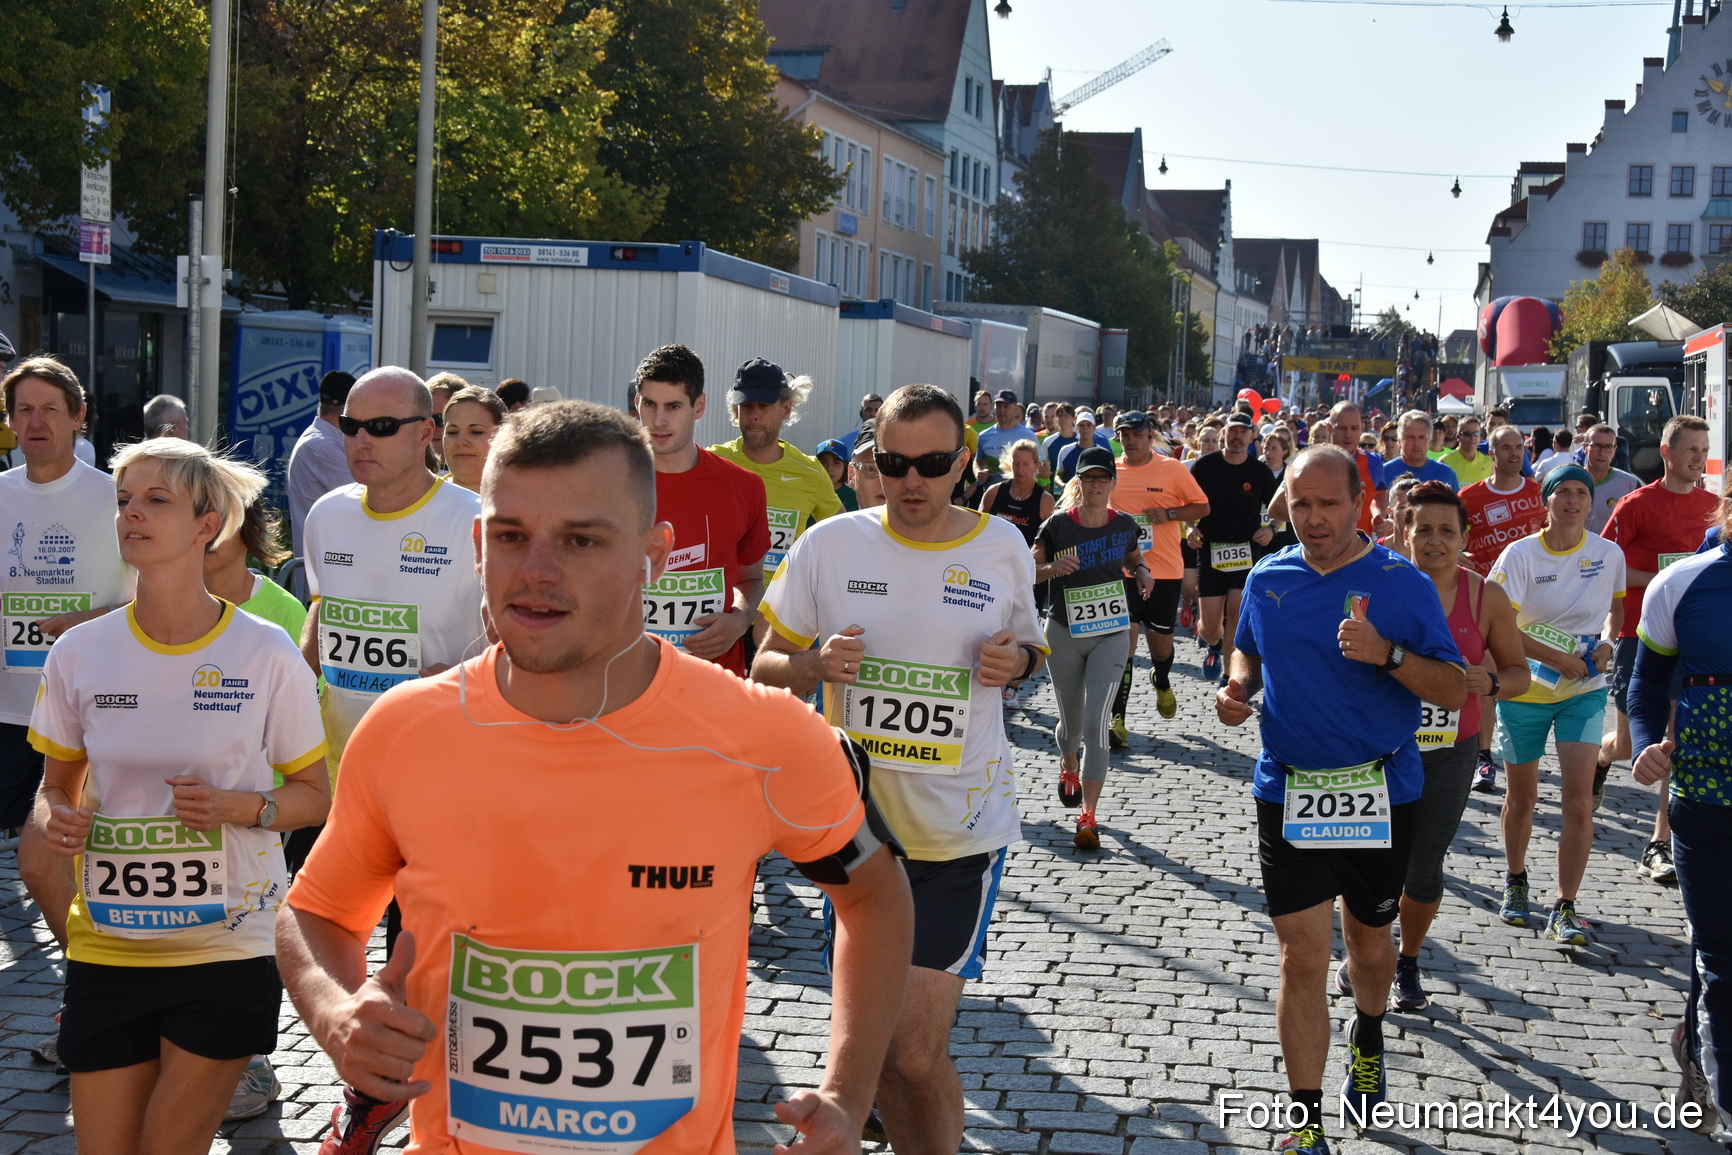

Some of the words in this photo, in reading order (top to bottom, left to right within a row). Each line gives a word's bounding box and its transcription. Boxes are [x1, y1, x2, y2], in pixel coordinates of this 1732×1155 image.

[497, 247, 509, 255] TOI
[69, 343, 86, 355] STRE
[1319, 361, 1357, 371] START
[1510, 496, 1544, 513] rau
[767, 511, 791, 526] CK
[403, 538, 424, 552] 20
[1078, 537, 1108, 556] START
[1112, 531, 1135, 546] EASY
[324, 552, 353, 563] BOCK
[401, 554, 453, 565] Neumarkter
[668, 552, 691, 566] DEHN
[765, 555, 778, 563] EL
[1216, 548, 1247, 561] 1036
[1077, 556, 1096, 570] SH
[1216, 561, 1247, 569] MATTHIAS
[9, 566, 21, 577] 8.
[24, 568, 74, 577] Neumarkter
[399, 565, 441, 577] Stadtlauf
[945, 569, 969, 585] 20
[36, 576, 74, 585] Stadtlauf
[847, 580, 888, 592] BOCK
[971, 580, 989, 590] JAHRE
[944, 585, 995, 603] Neumarkter
[1069, 584, 1119, 602] BOCK
[10, 597, 82, 612] BOCK
[943, 596, 985, 612] Stadtlauf
[1074, 600, 1121, 621] 2316
[326, 601, 408, 629] BOCK
[644, 599, 714, 626] 2175
[1080, 620, 1119, 632] CLAUDIA
[657, 633, 690, 645] HOM
[329, 632, 407, 668] 2766
[195, 671, 221, 687] 20
[856, 661, 960, 695] BOCK
[95, 695, 138, 705] BOCK
[194, 690, 255, 700] Neumarkter
[193, 702, 242, 713] Stadtlauf
[859, 696, 954, 737] 1205
[1421, 707, 1449, 728] 33
[1415, 734, 1443, 743] HRIN
[861, 738, 942, 761] MICHAEL
[1297, 793, 1377, 818] 2032
[92, 822, 209, 849] BOCK
[1301, 826, 1372, 838] CLAUDIO
[96, 860, 208, 898] 2633
[628, 864, 715, 890] THULE
[109, 909, 202, 926] BETTINA
[464, 948, 675, 1005] BOCK
[472, 1016, 666, 1088] 2537
[676, 1027, 687, 1039] D
[500, 1101, 636, 1136] MARCO
